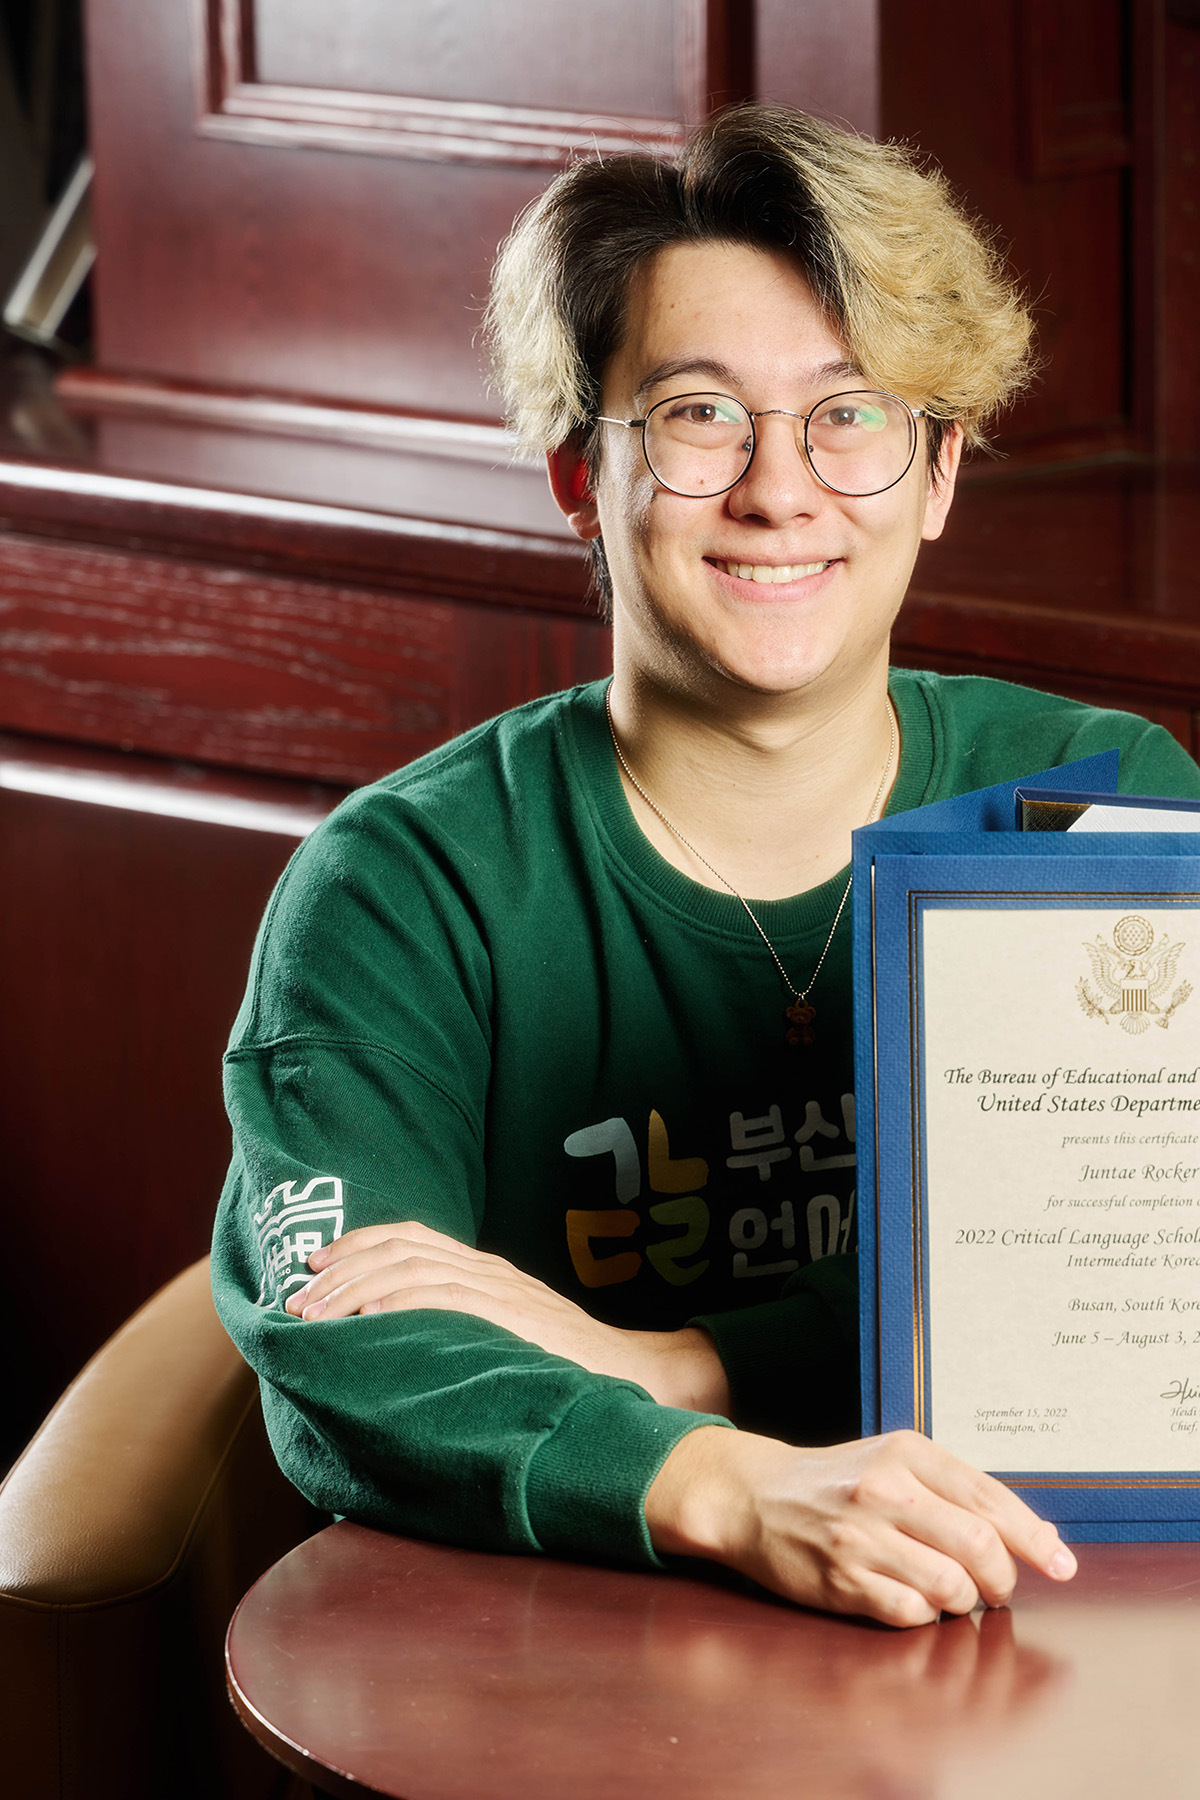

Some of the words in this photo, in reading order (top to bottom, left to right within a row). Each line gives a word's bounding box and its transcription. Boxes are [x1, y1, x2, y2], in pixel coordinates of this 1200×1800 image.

[944, 1067, 973, 1084] The
[978, 1069, 1037, 1084] Bureau
[1042, 1067, 1062, 1089] of
[1063, 1067, 1166, 1084] Educational
[1167, 1067, 1200, 1083] and
[977, 1093, 1046, 1112] United
[1047, 1095, 1105, 1113] States
[1062, 1136, 1110, 1148] presents
[1114, 1132, 1135, 1144] this
[1139, 1132, 1198, 1148] certificate
[1079, 1165, 1136, 1182] Juntae
[1142, 1162, 1200, 1183] Rocker
[1044, 1195, 1065, 1211] for
[1068, 1195, 1128, 1211] successful
[1129, 1195, 1192, 1210] completion
[955, 1229, 995, 1244] 2022
[1002, 1227, 1067, 1246] Critical
[1069, 1229, 1149, 1249] Language
[1067, 1252, 1157, 1267] Intermediate
[1068, 1299, 1116, 1312] Busan,
[1122, 1296, 1164, 1312] South
[1052, 1332, 1086, 1346] June
[1091, 1332, 1100, 1344] 5
[1116, 1331, 1169, 1348] August
[1175, 1331, 1186, 1345] 3,
[977, 1408, 1023, 1420] September
[1028, 1409, 1039, 1417] 15,
[1044, 1408, 1067, 1417] 2022
[1172, 1407, 1196, 1416] Heidi
[977, 1422, 1035, 1434] Washington,
[1041, 1423, 1060, 1432] D.C.
[1171, 1421, 1197, 1434] Chief,
